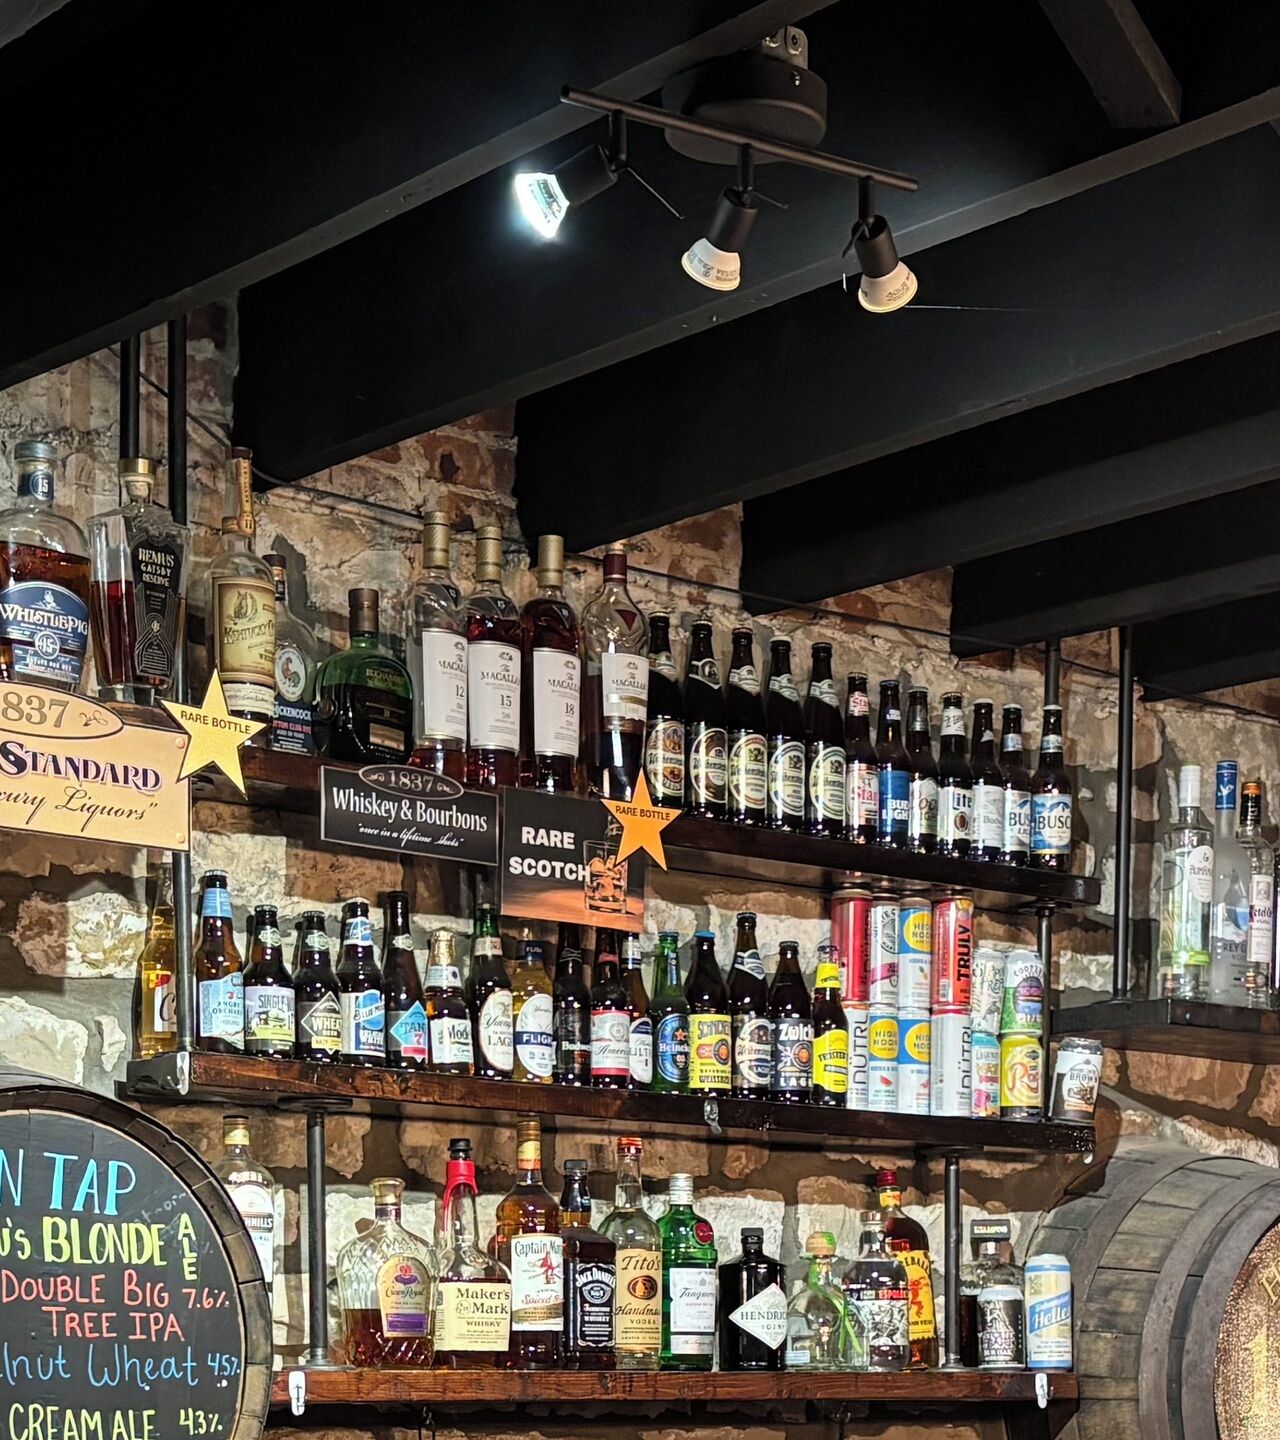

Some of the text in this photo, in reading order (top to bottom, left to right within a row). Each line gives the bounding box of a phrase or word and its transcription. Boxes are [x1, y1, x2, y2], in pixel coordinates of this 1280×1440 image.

[138, 547, 175, 567] REMUS
[455, 684, 464, 698] 12
[500, 694, 512, 708] 15
[565, 702, 575, 716] 18
[180, 710, 209, 725] RARE
[212, 716, 252, 735] BOTTLE
[387, 771, 434, 793] 1837
[332, 787, 488, 832] Whiskey & Bourbons
[616, 805, 671, 821] RARE BOTTLE
[521, 826, 576, 850] RARE
[509, 857, 591, 882] SCOTCH
[957, 924, 972, 982] TRULY
[43, 1151, 137, 1215] TAP
[42, 1216, 167, 1267] BLONDE
[515, 1240, 548, 1258] Captain
[622, 1254, 661, 1272] Tito's
[1, 1269, 106, 1304] DOUBLE
[123, 1269, 170, 1308] BIG
[181, 1288, 230, 1309] 7.6%
[456, 1288, 510, 1300] Maker's
[472, 1302, 509, 1315] Mark
[41, 1305, 186, 1343] TREE IPA
[87, 1342, 199, 1388] Wheat
